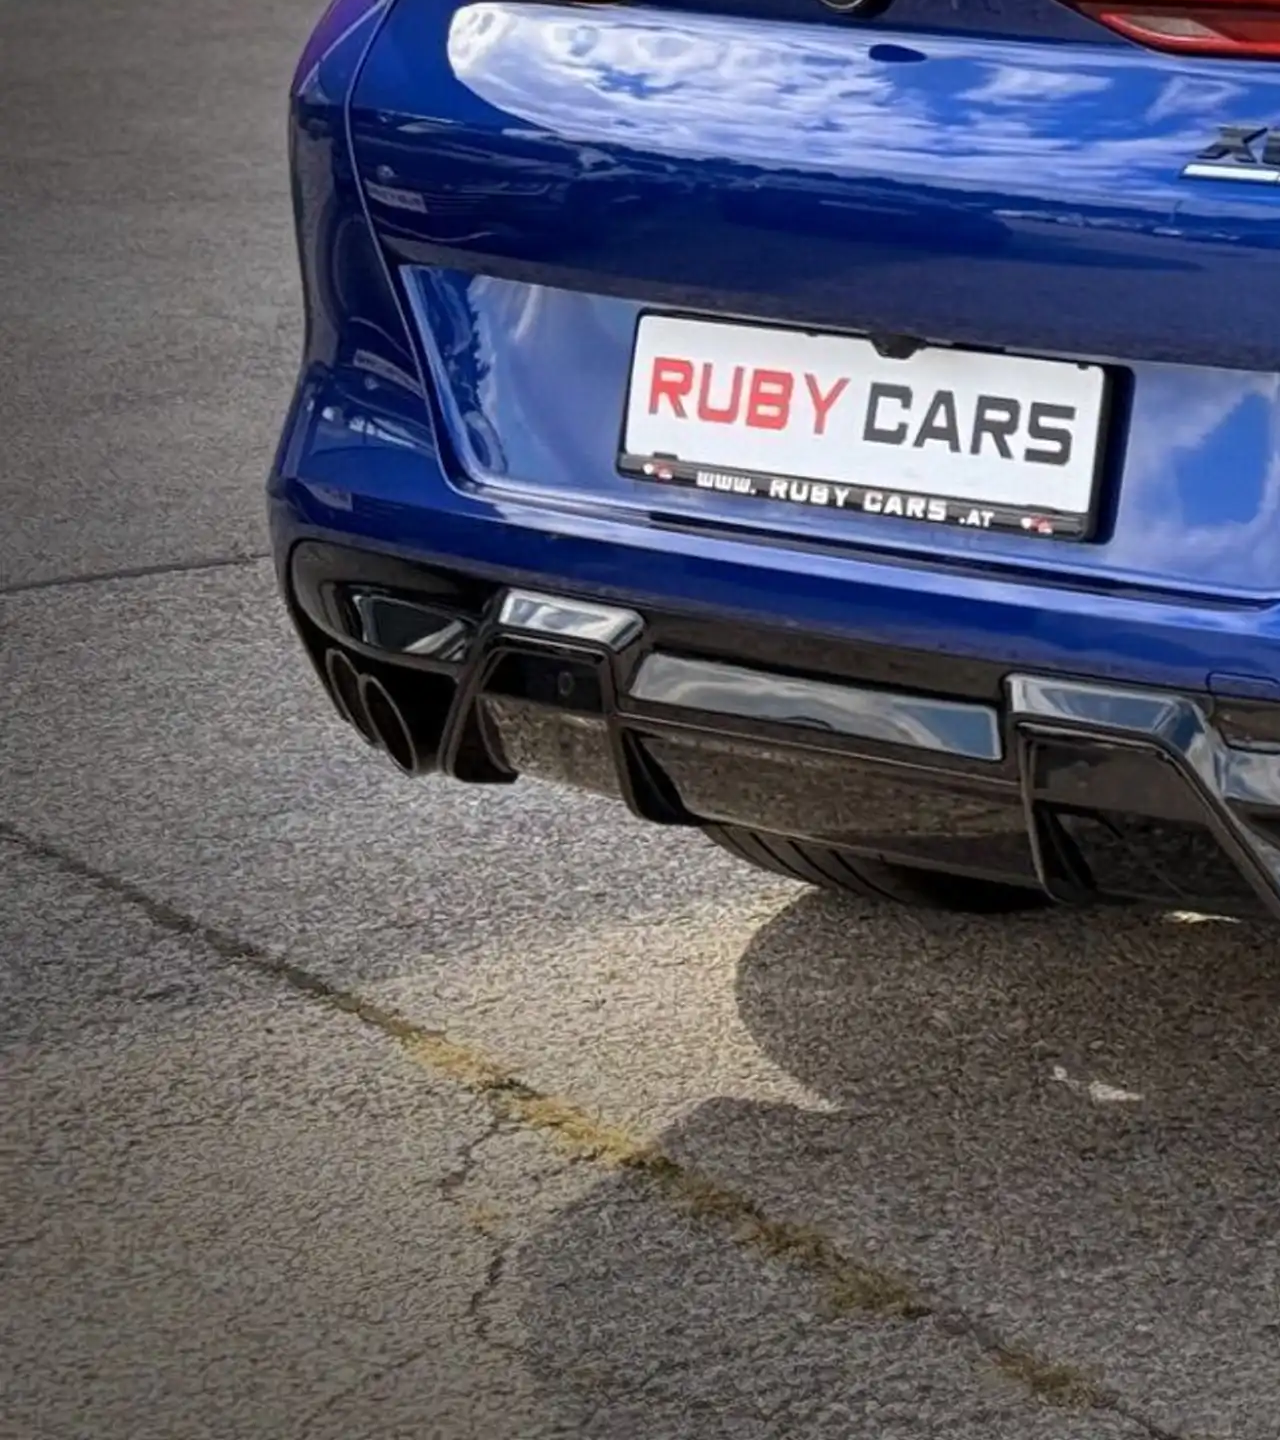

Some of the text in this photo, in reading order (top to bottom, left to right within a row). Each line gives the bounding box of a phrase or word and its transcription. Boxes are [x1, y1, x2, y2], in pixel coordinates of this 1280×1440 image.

[647, 356, 1076, 467] RUBY CARS
[769, 478, 850, 508] RUBY
[863, 491, 947, 522] CARS
[958, 508, 995, 528] .AT
